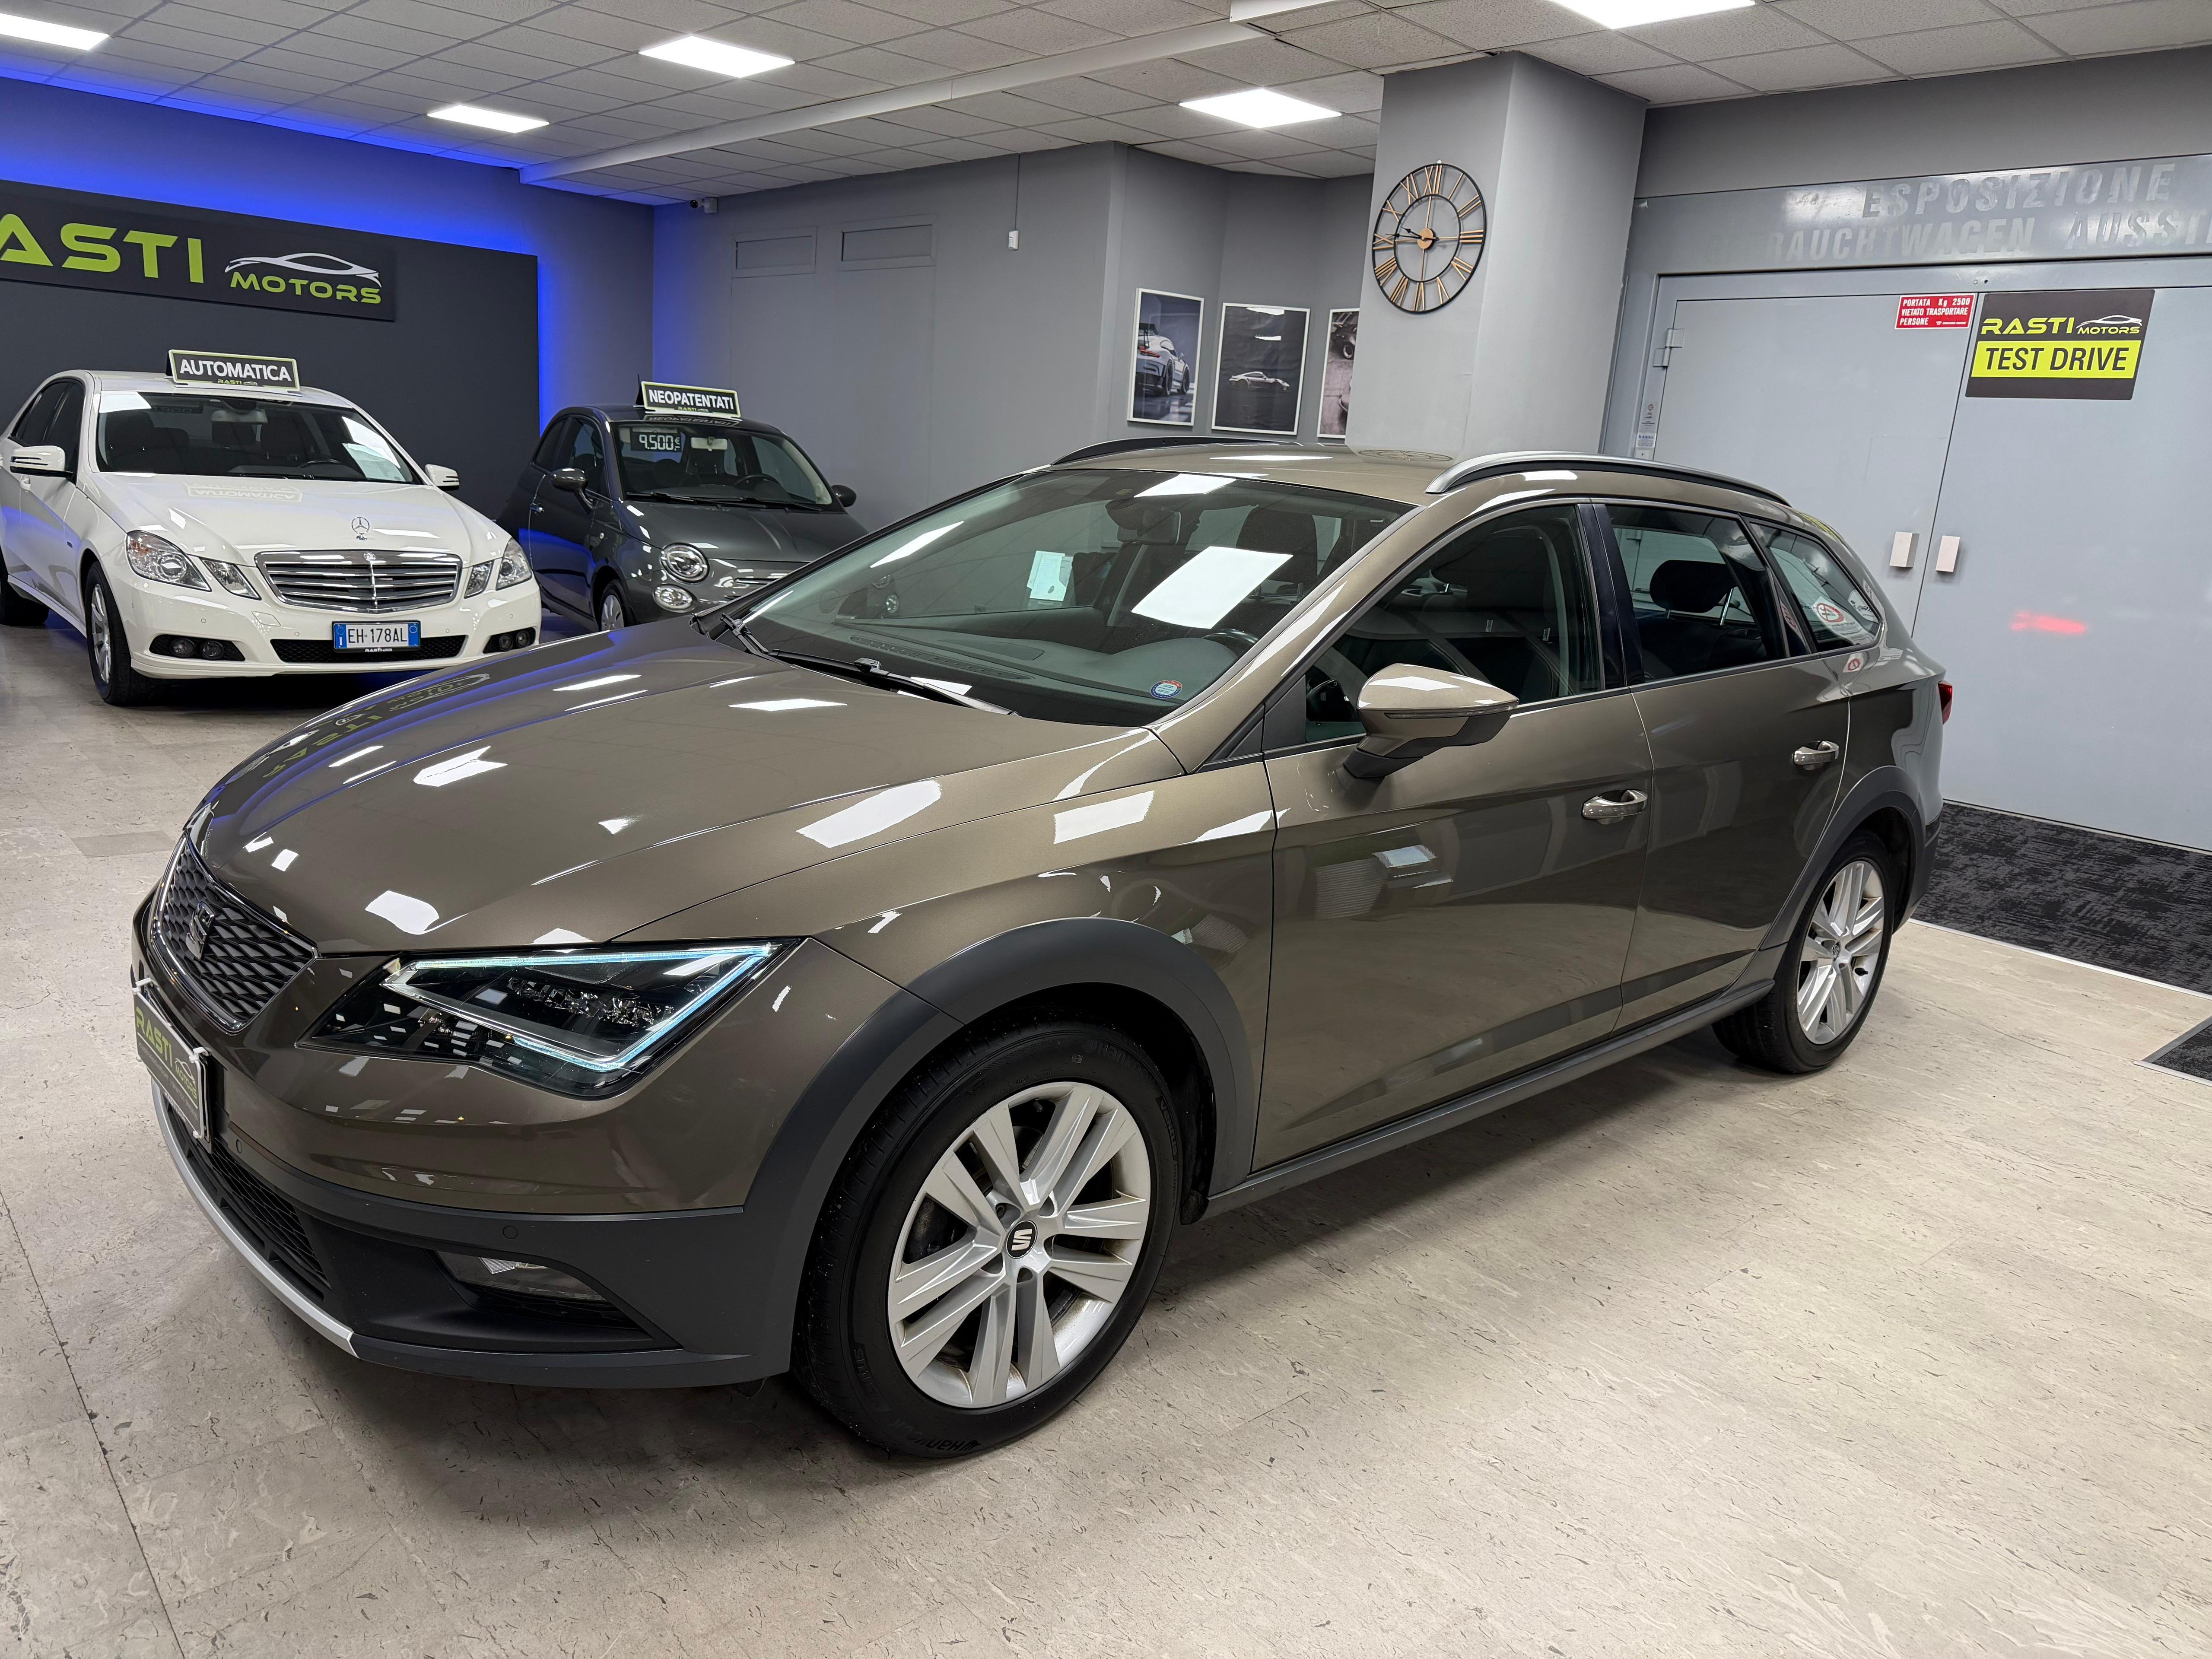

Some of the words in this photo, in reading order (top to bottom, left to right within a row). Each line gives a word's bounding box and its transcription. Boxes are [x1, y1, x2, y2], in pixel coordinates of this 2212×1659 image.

[1862, 164, 2176, 218] ESPOSIZIONE
[2064, 209, 2212, 250] AUSST
[230, 271, 381, 304] MOTORS
[1926, 307, 1968, 316] TRASPORTARE
[1938, 298, 1948, 307] Kg
[1981, 317, 2075, 334] RASTI
[2077, 326, 2141, 334] MOTORS
[180, 359, 292, 381] AUTOMATICA
[1986, 347, 2044, 370] TEST
[2050, 347, 2129, 371] DRIVE
[648, 389, 734, 410] NEOPATENTATI
[348, 629, 364, 643] EH
[370, 628, 407, 643] 178AL
[136, 1006, 173, 1068] RASTI
